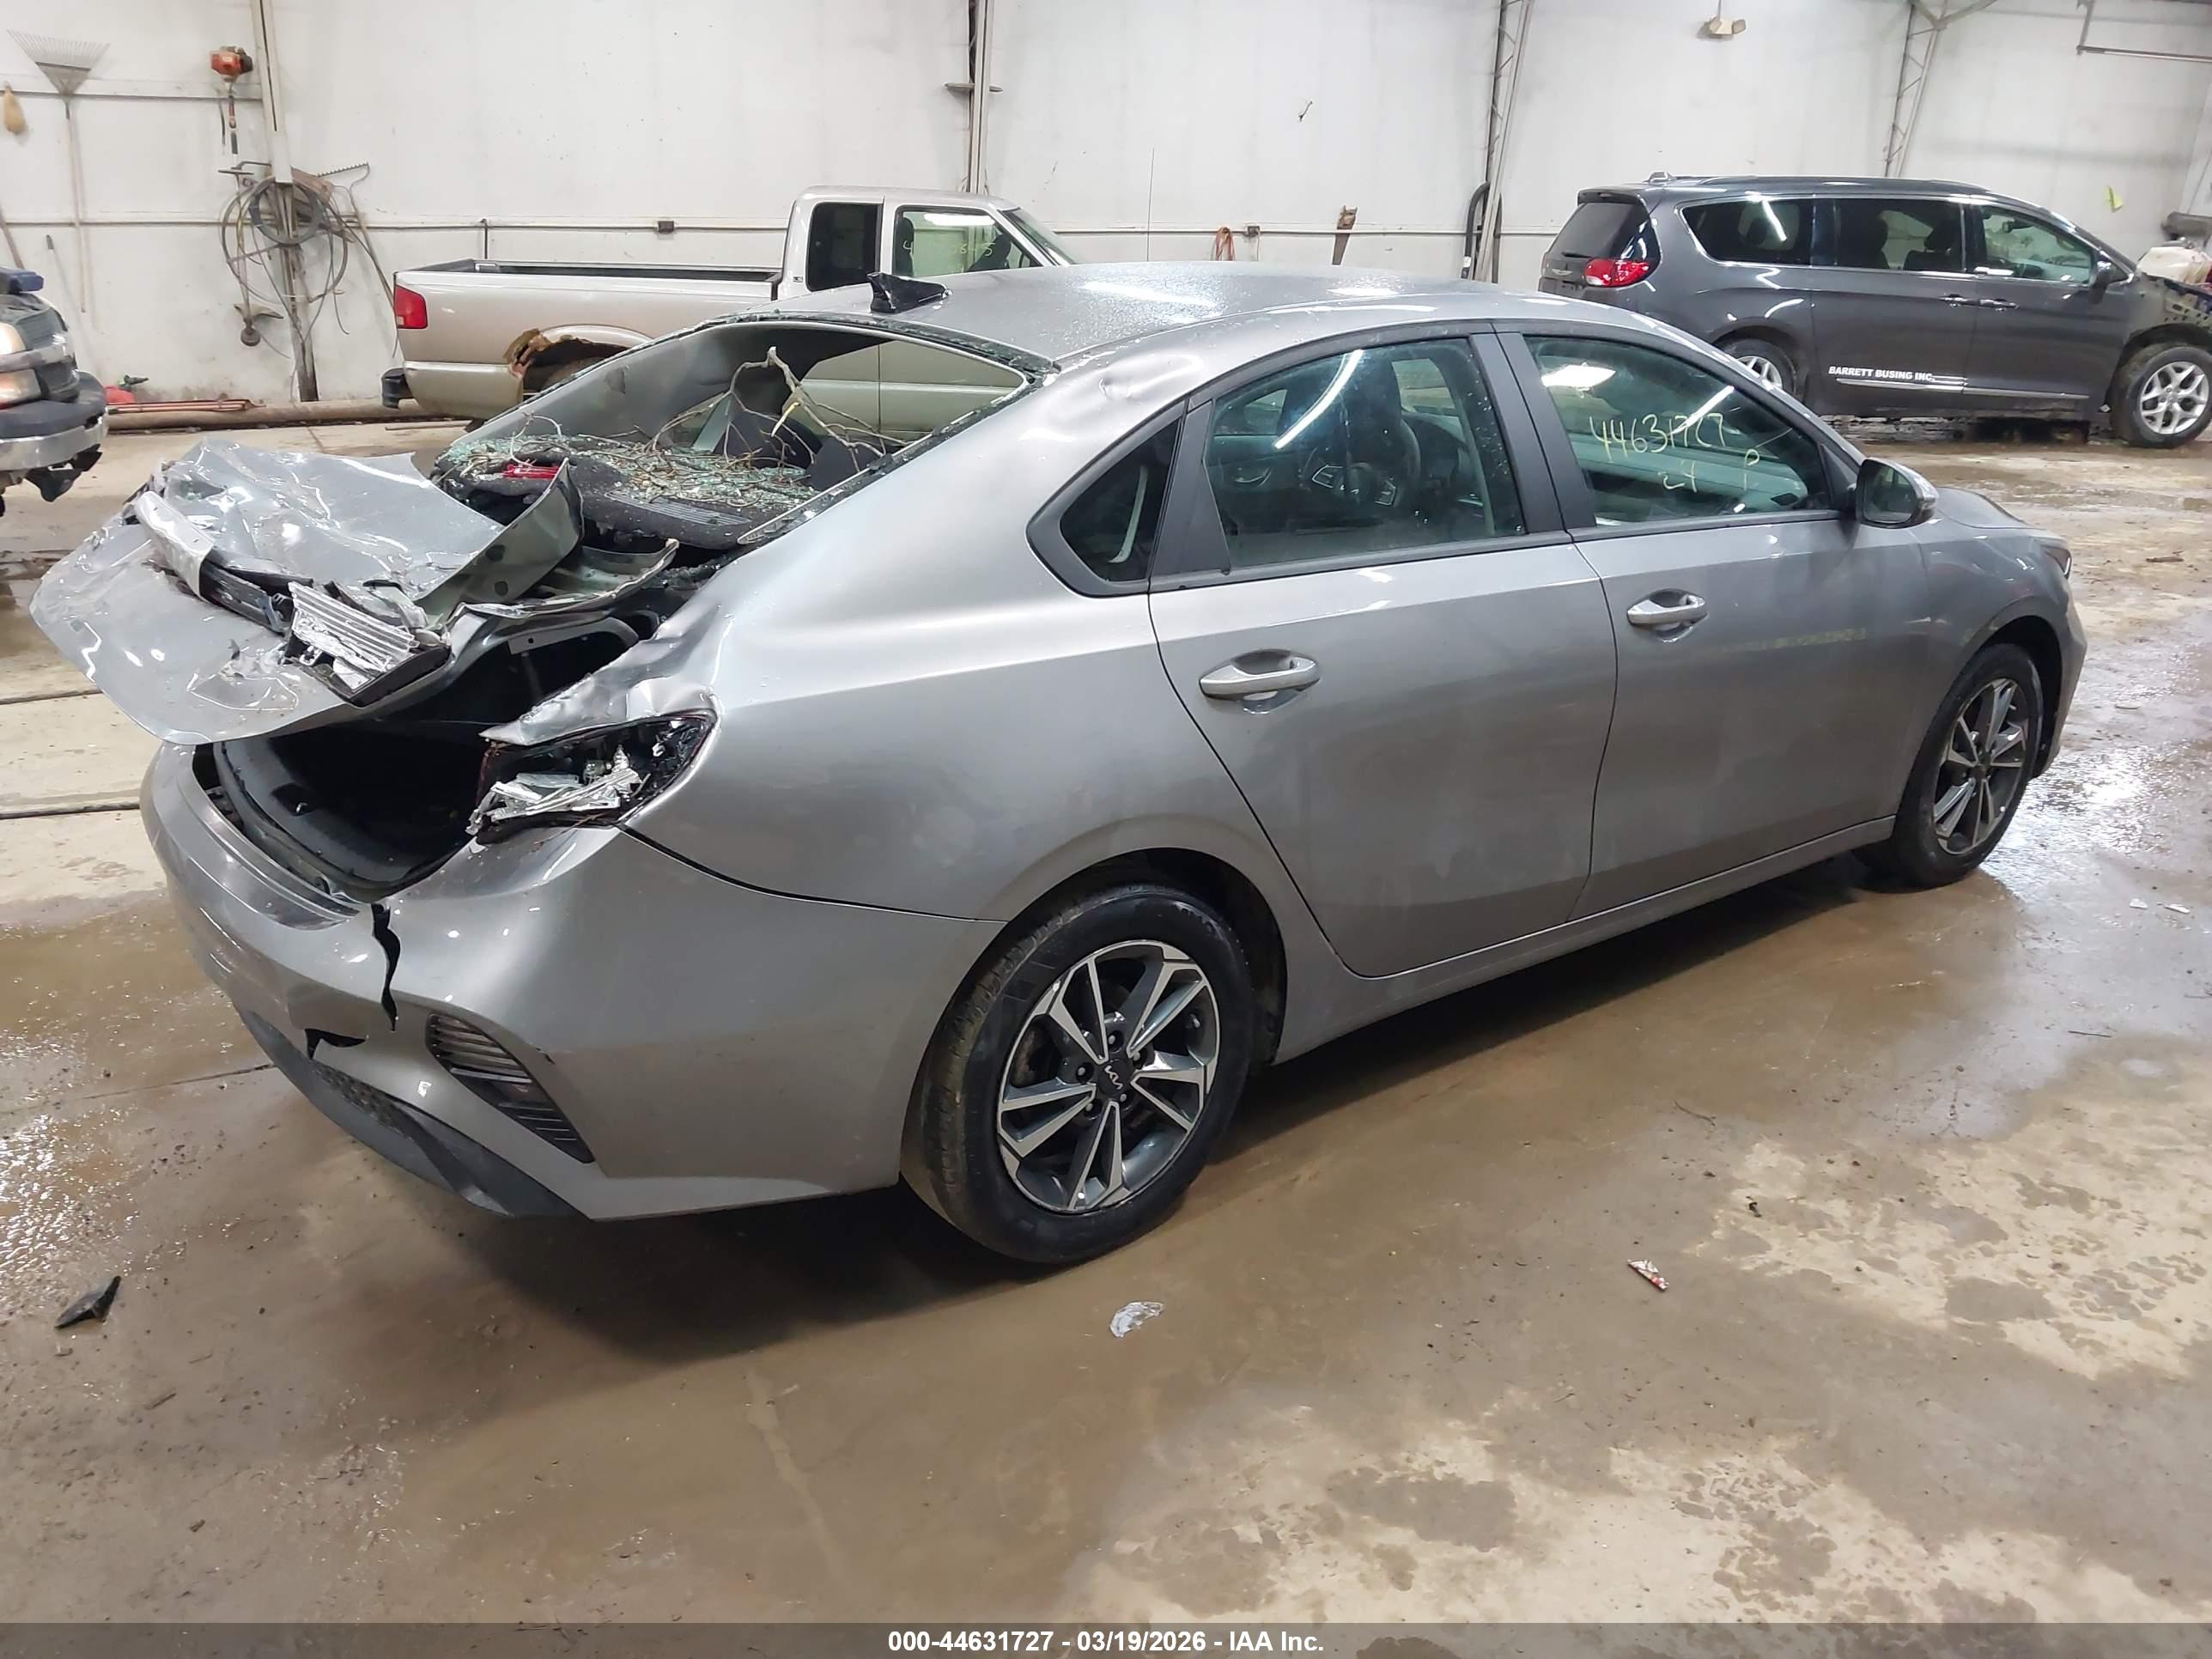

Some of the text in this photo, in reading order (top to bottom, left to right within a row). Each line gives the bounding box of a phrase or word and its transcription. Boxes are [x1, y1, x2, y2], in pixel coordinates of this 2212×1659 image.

[1827, 366, 1936, 381] BARRETT BUSING INC.
